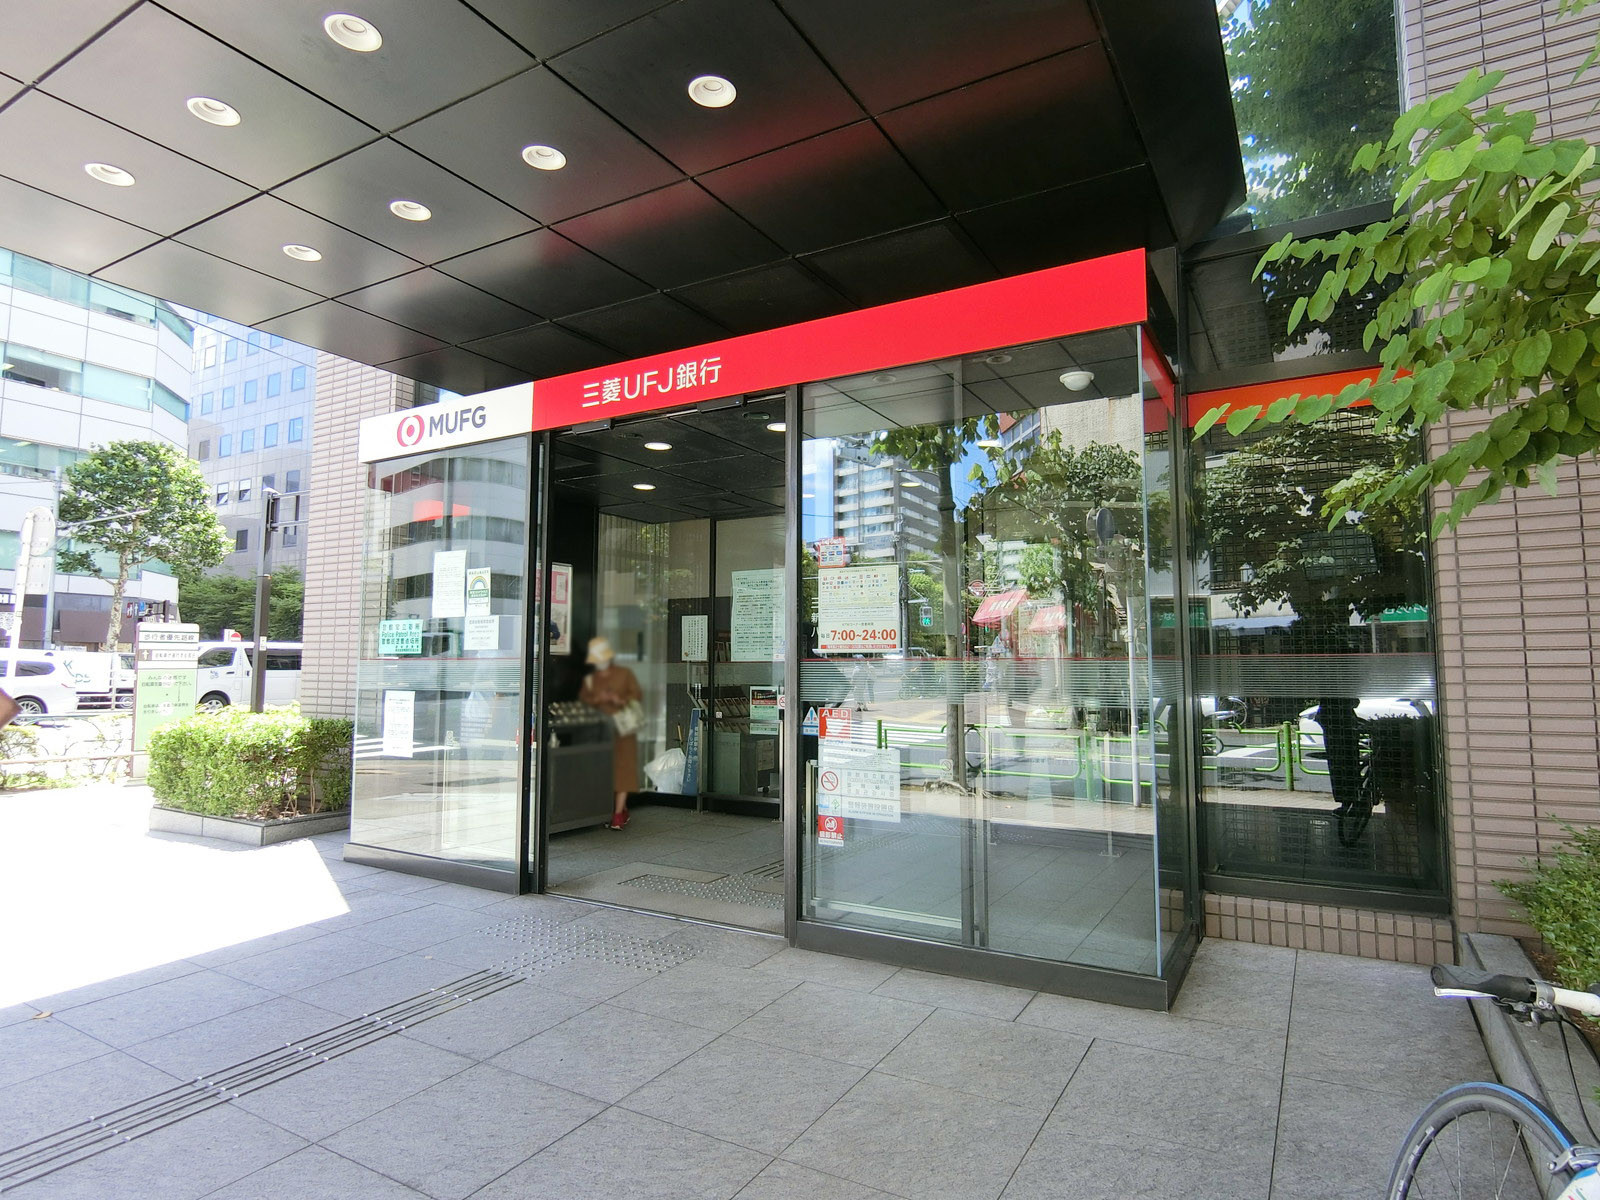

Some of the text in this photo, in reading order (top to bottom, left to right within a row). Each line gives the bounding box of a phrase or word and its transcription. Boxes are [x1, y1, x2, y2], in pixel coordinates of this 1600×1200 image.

[582, 357, 722, 408] 三菱UFJ銀行
[429, 405, 486, 437] MUFG
[821, 709, 849, 718] AED
